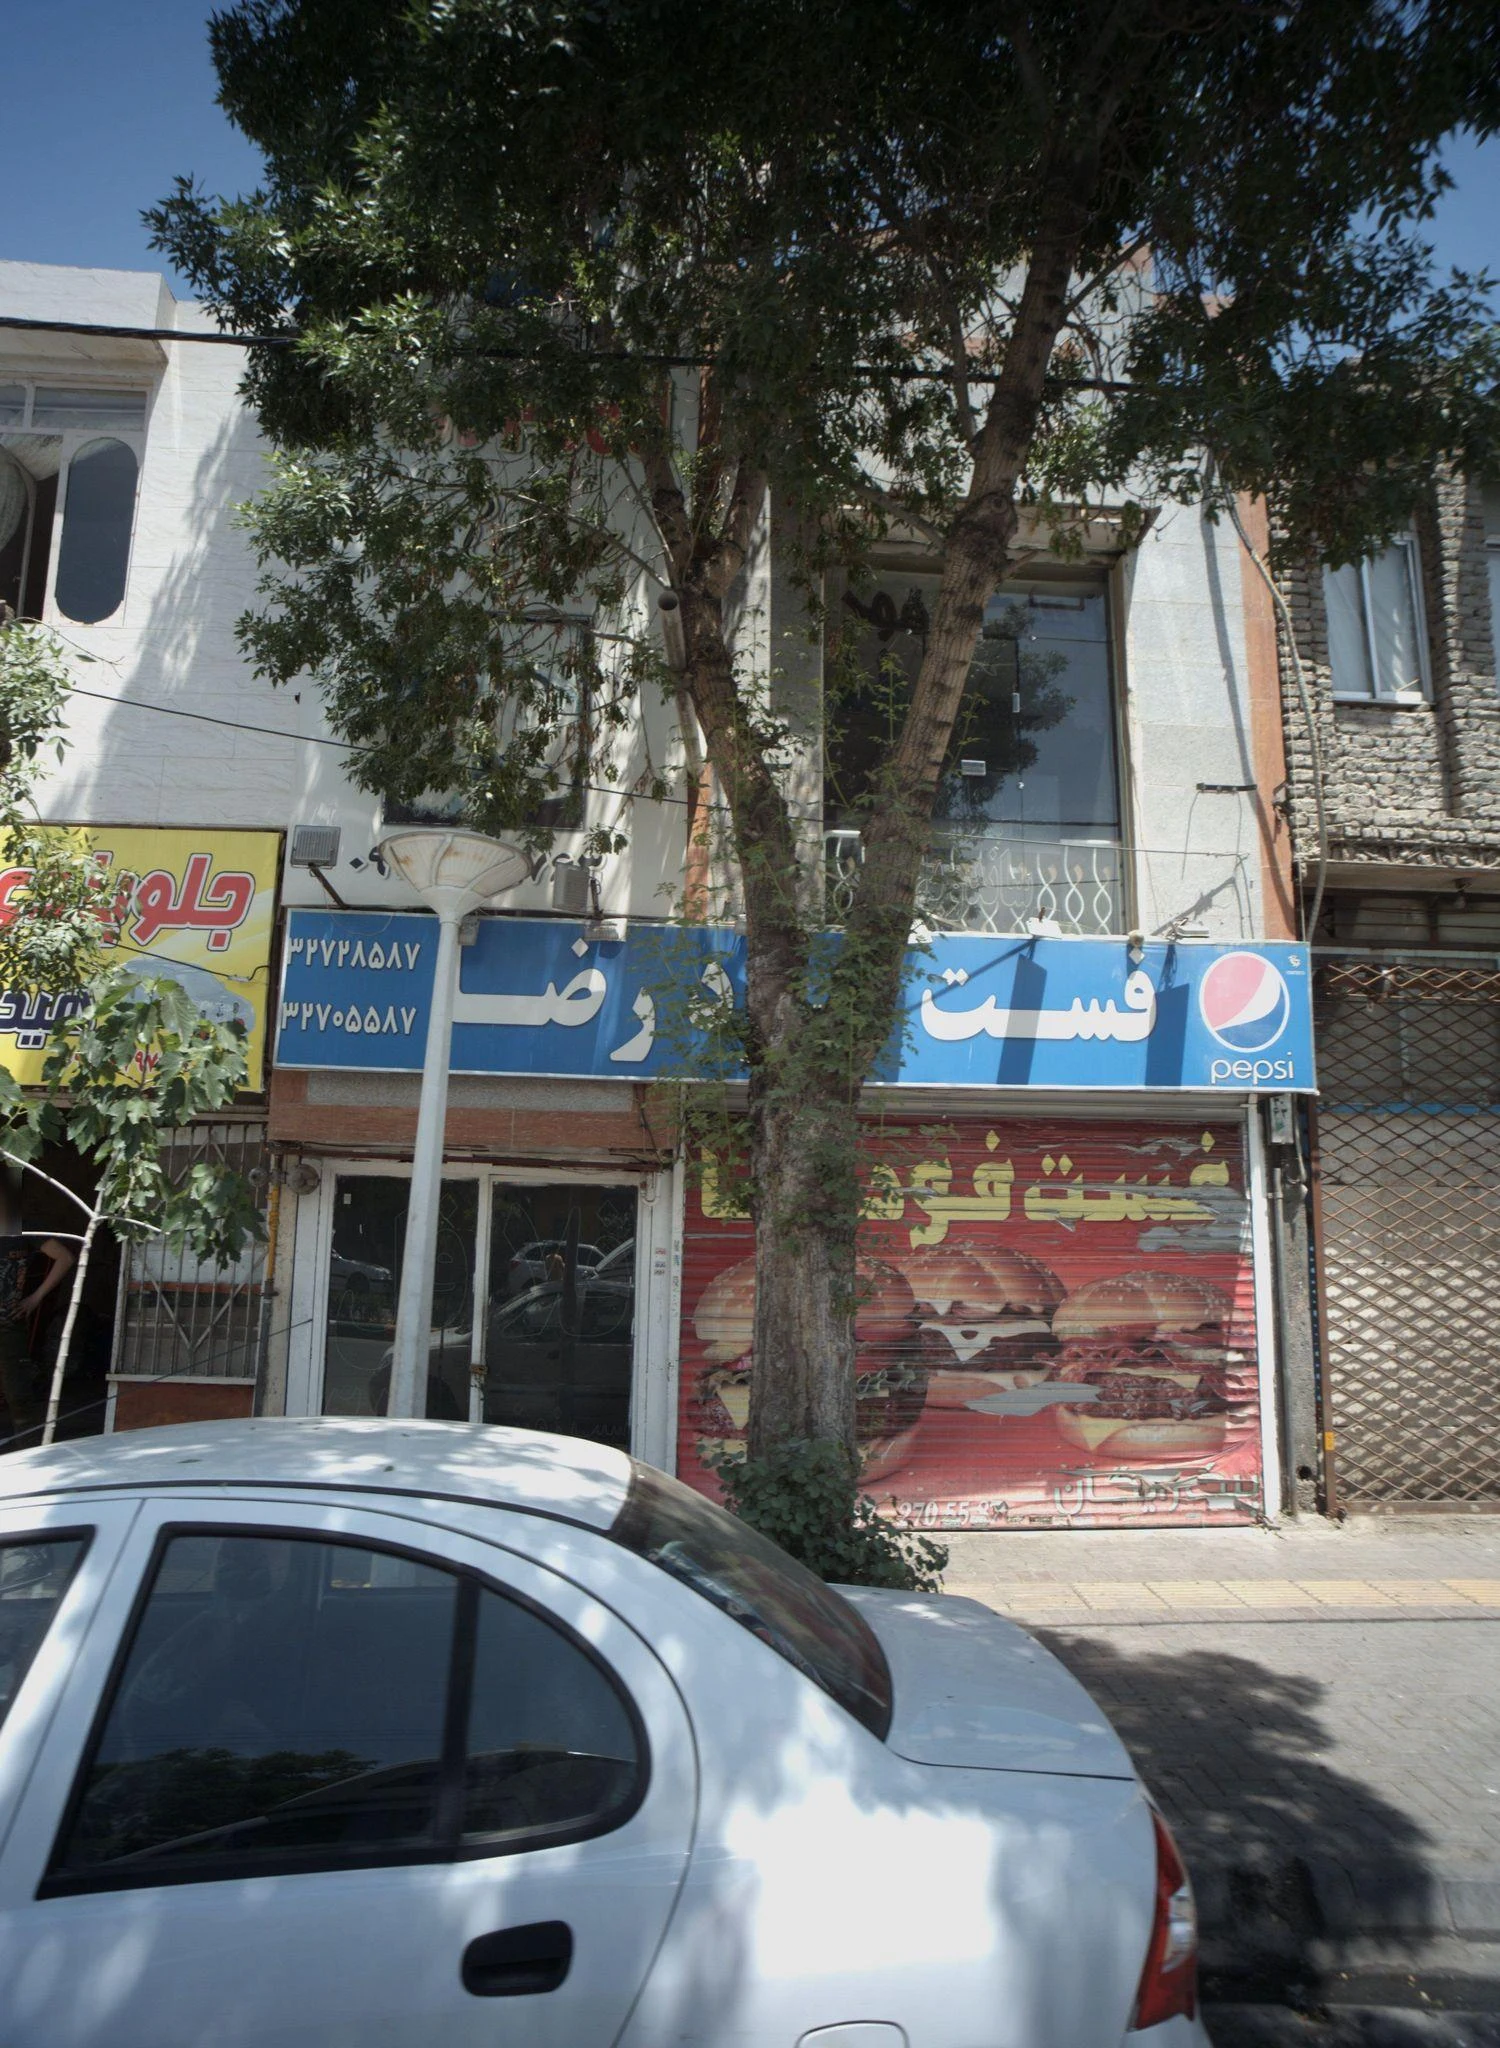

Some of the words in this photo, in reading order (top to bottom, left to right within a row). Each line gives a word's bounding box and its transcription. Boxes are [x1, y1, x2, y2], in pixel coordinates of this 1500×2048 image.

[286, 937, 421, 971] ۳۲۷۲۸۵۸۷
[281, 1001, 417, 1036] ۳۲۷۰۵۵۸۷
[450, 937, 656, 1063] رض
[920, 947, 1157, 1042] فست
[1210, 1051, 1295, 1085] pepsi
[1024, 1130, 1231, 1222] فست
